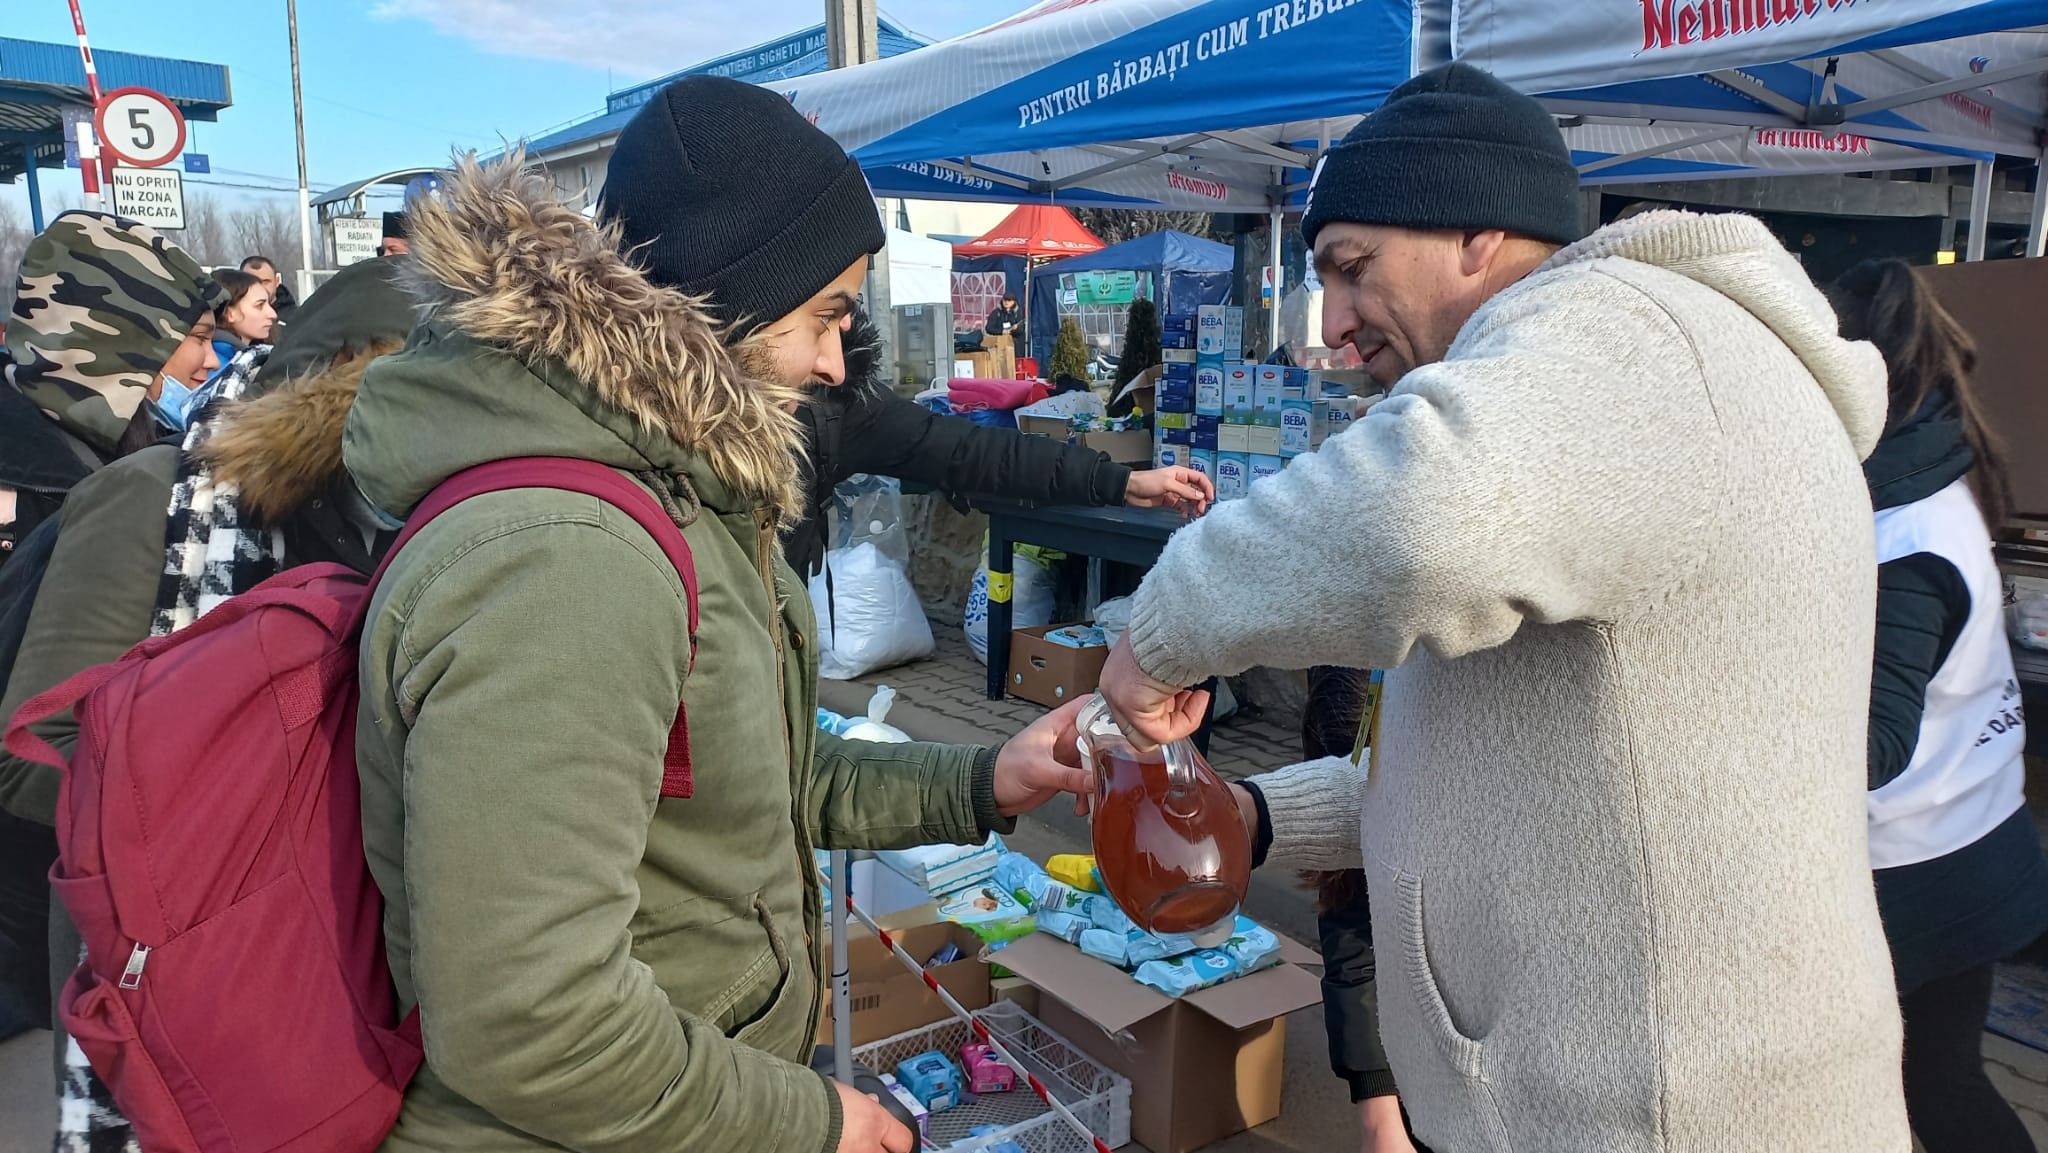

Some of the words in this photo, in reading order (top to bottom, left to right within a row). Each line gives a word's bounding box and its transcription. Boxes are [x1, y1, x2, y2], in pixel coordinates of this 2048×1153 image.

[1632, 0, 1859, 58] Neuma
[760, 41, 801, 66] SIGHETU
[1018, 79, 1092, 129] PENTRU
[1096, 40, 1190, 100] BĂRBAȚI
[1196, 16, 1249, 61] CUM
[1257, 0, 1363, 39] TREB
[127, 108, 155, 150] 5
[115, 175, 132, 186] NU
[136, 176, 177, 189] OPRITI
[122, 190, 134, 201] IN
[138, 191, 172, 203] ZONA
[119, 205, 178, 218] MARCATA
[1200, 317, 1223, 327] BEBA
[1198, 374, 1219, 385] BEBA
[1283, 414, 1307, 426] BEBA
[1302, 430, 1308, 439] 4
[1220, 465, 1241, 477] BEBA
